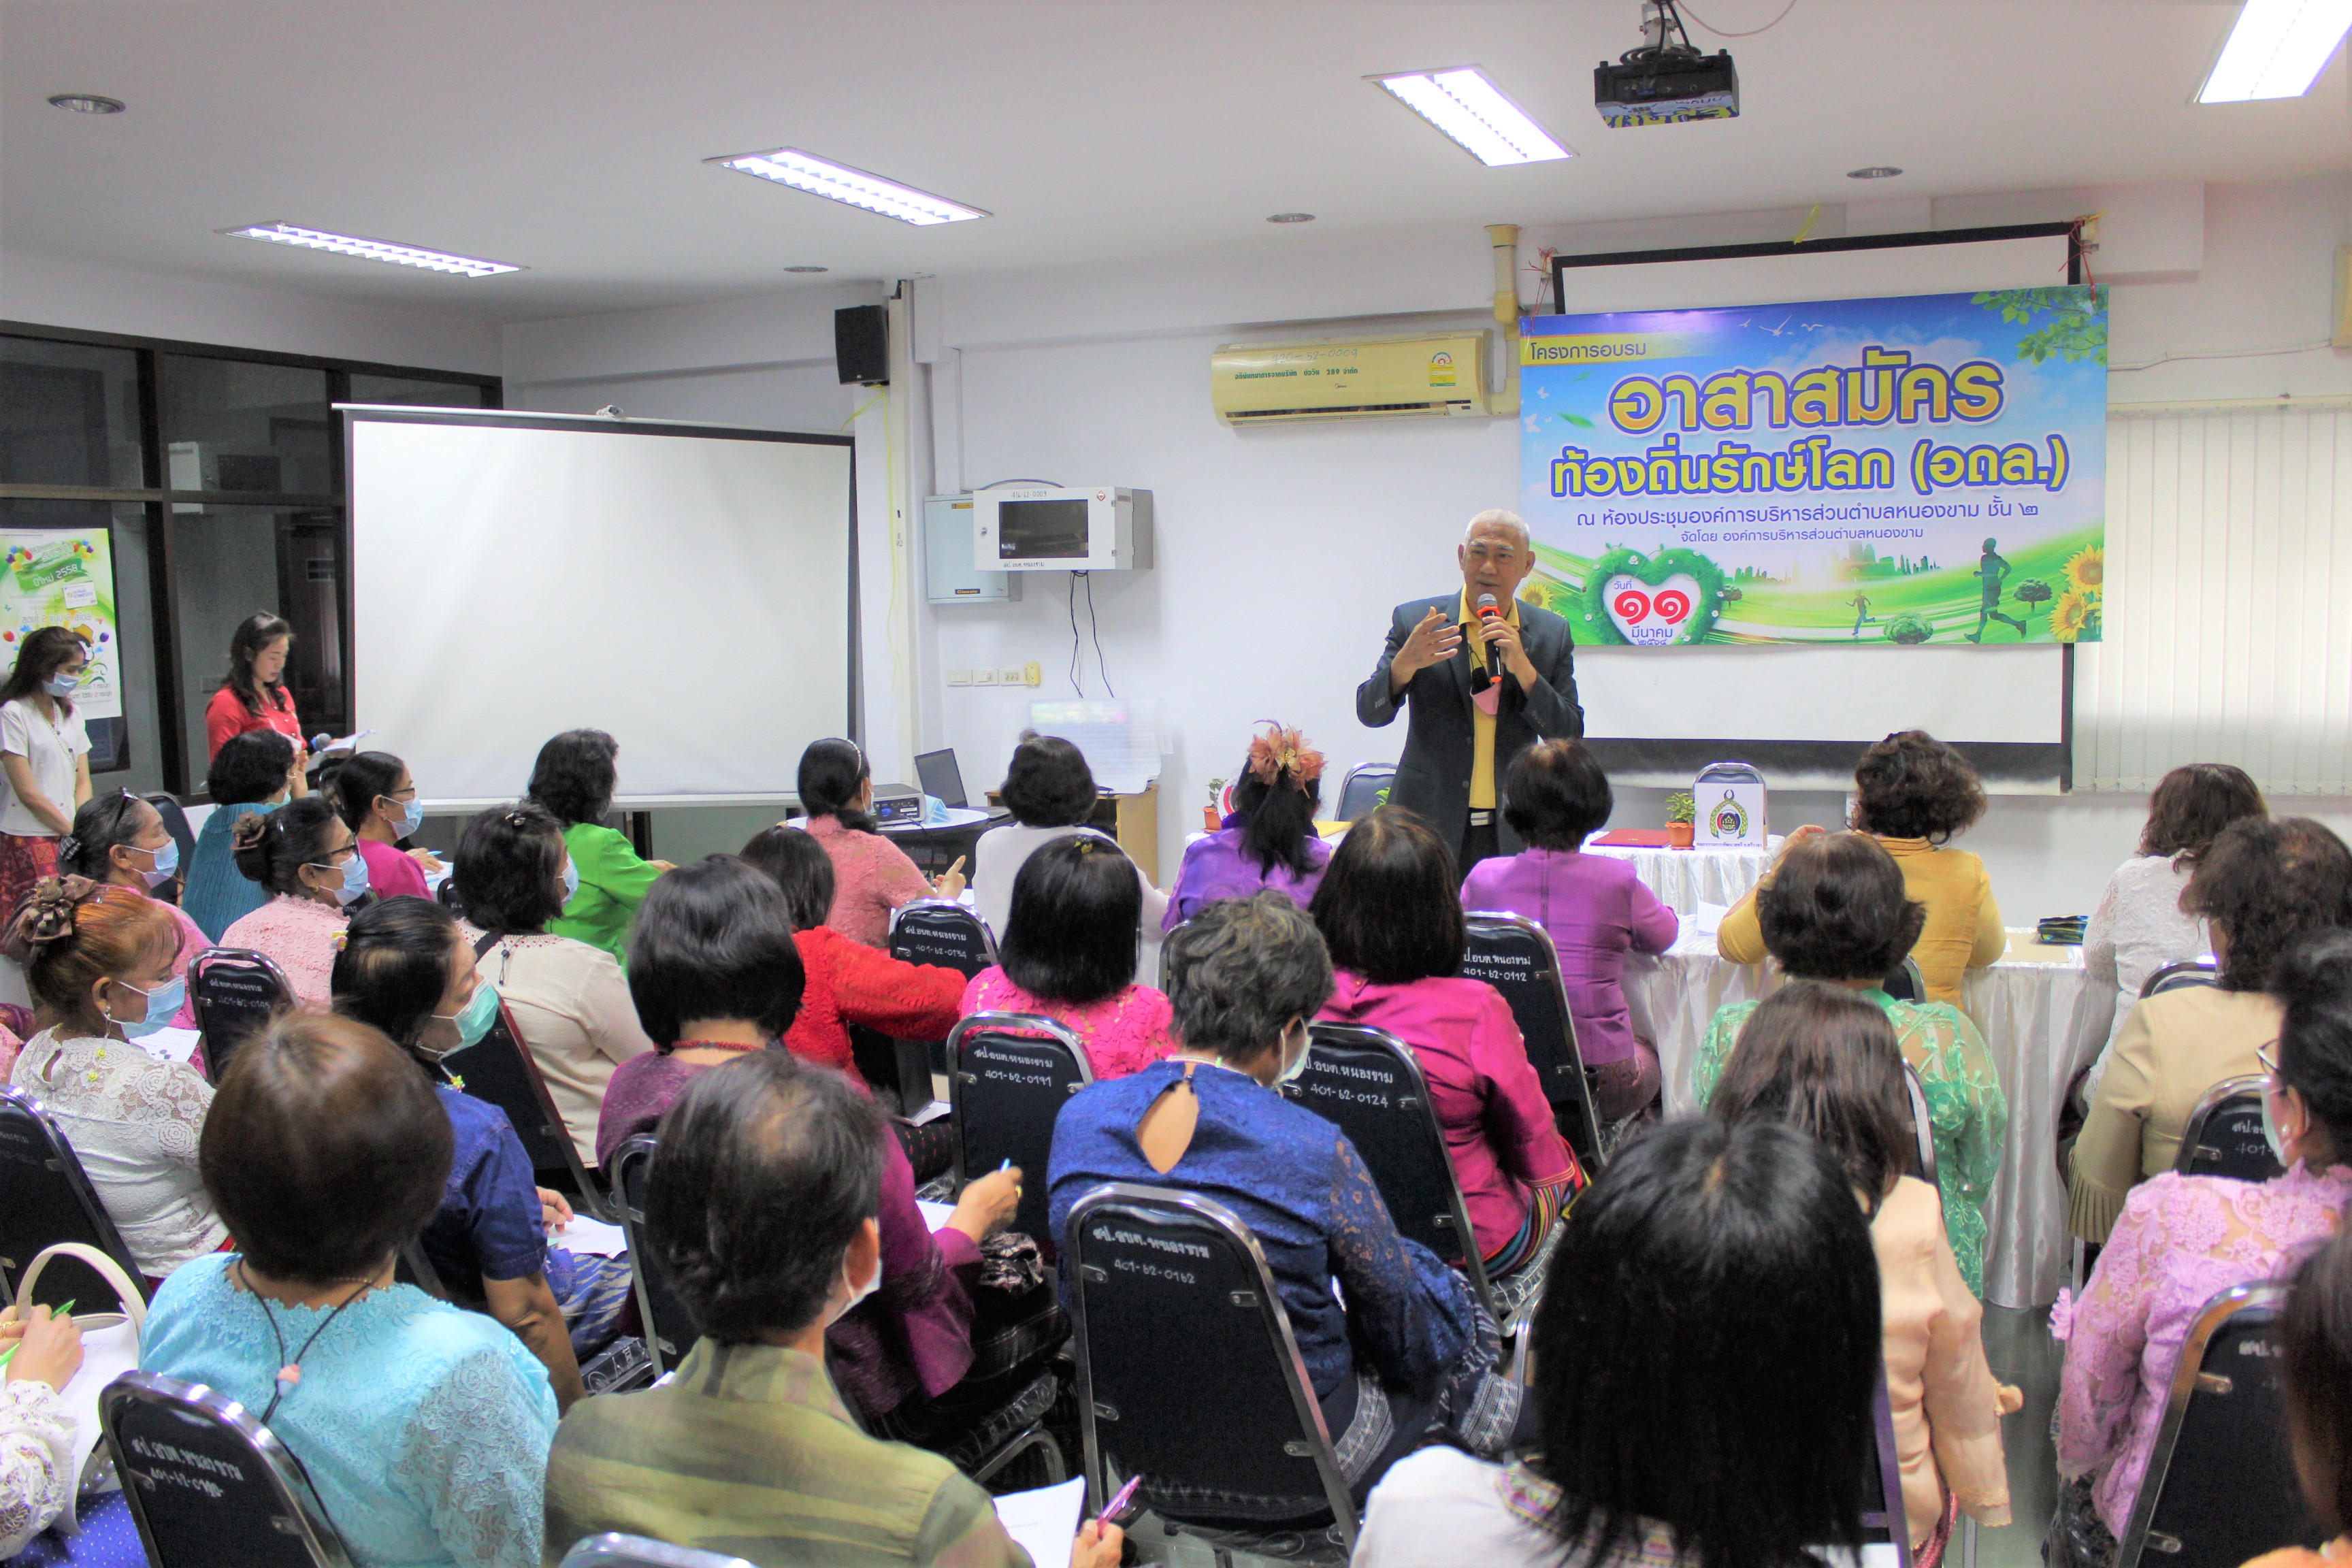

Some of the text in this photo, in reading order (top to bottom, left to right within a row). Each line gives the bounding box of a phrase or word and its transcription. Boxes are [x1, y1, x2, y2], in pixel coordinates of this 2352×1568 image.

[1531, 342, 1646, 360] โครงการอบรม
[1609, 346, 2003, 434] อาสาสมัคร
[1552, 434, 2068, 496] ท้องถิ่นรักษ์โลก (อถล.)
[1578, 495, 2038, 528] ณ ห้องประชุมองค์การบริหารส่วนตำบลหนองขาม ชั้น ๒
[1681, 527, 1923, 542] จัดโดย องค์การบริหารส่วนตำบลหนองขาม
[56, 564, 78, 579] 2558
[1614, 578, 1632, 589] วันที่
[1614, 590, 1690, 625] ๑๑
[1631, 625, 1673, 638] มีนาคม
[1464, 947, 1531, 965] ป.อบต.หนองขาม
[1463, 968, 1526, 981] 401-62-0112
[1305, 1056, 1392, 1083] ป.อบต.หนองขาม
[1310, 1083, 1388, 1108] 401-62-0124
[1114, 1259, 1195, 1284] 401-62-0162
